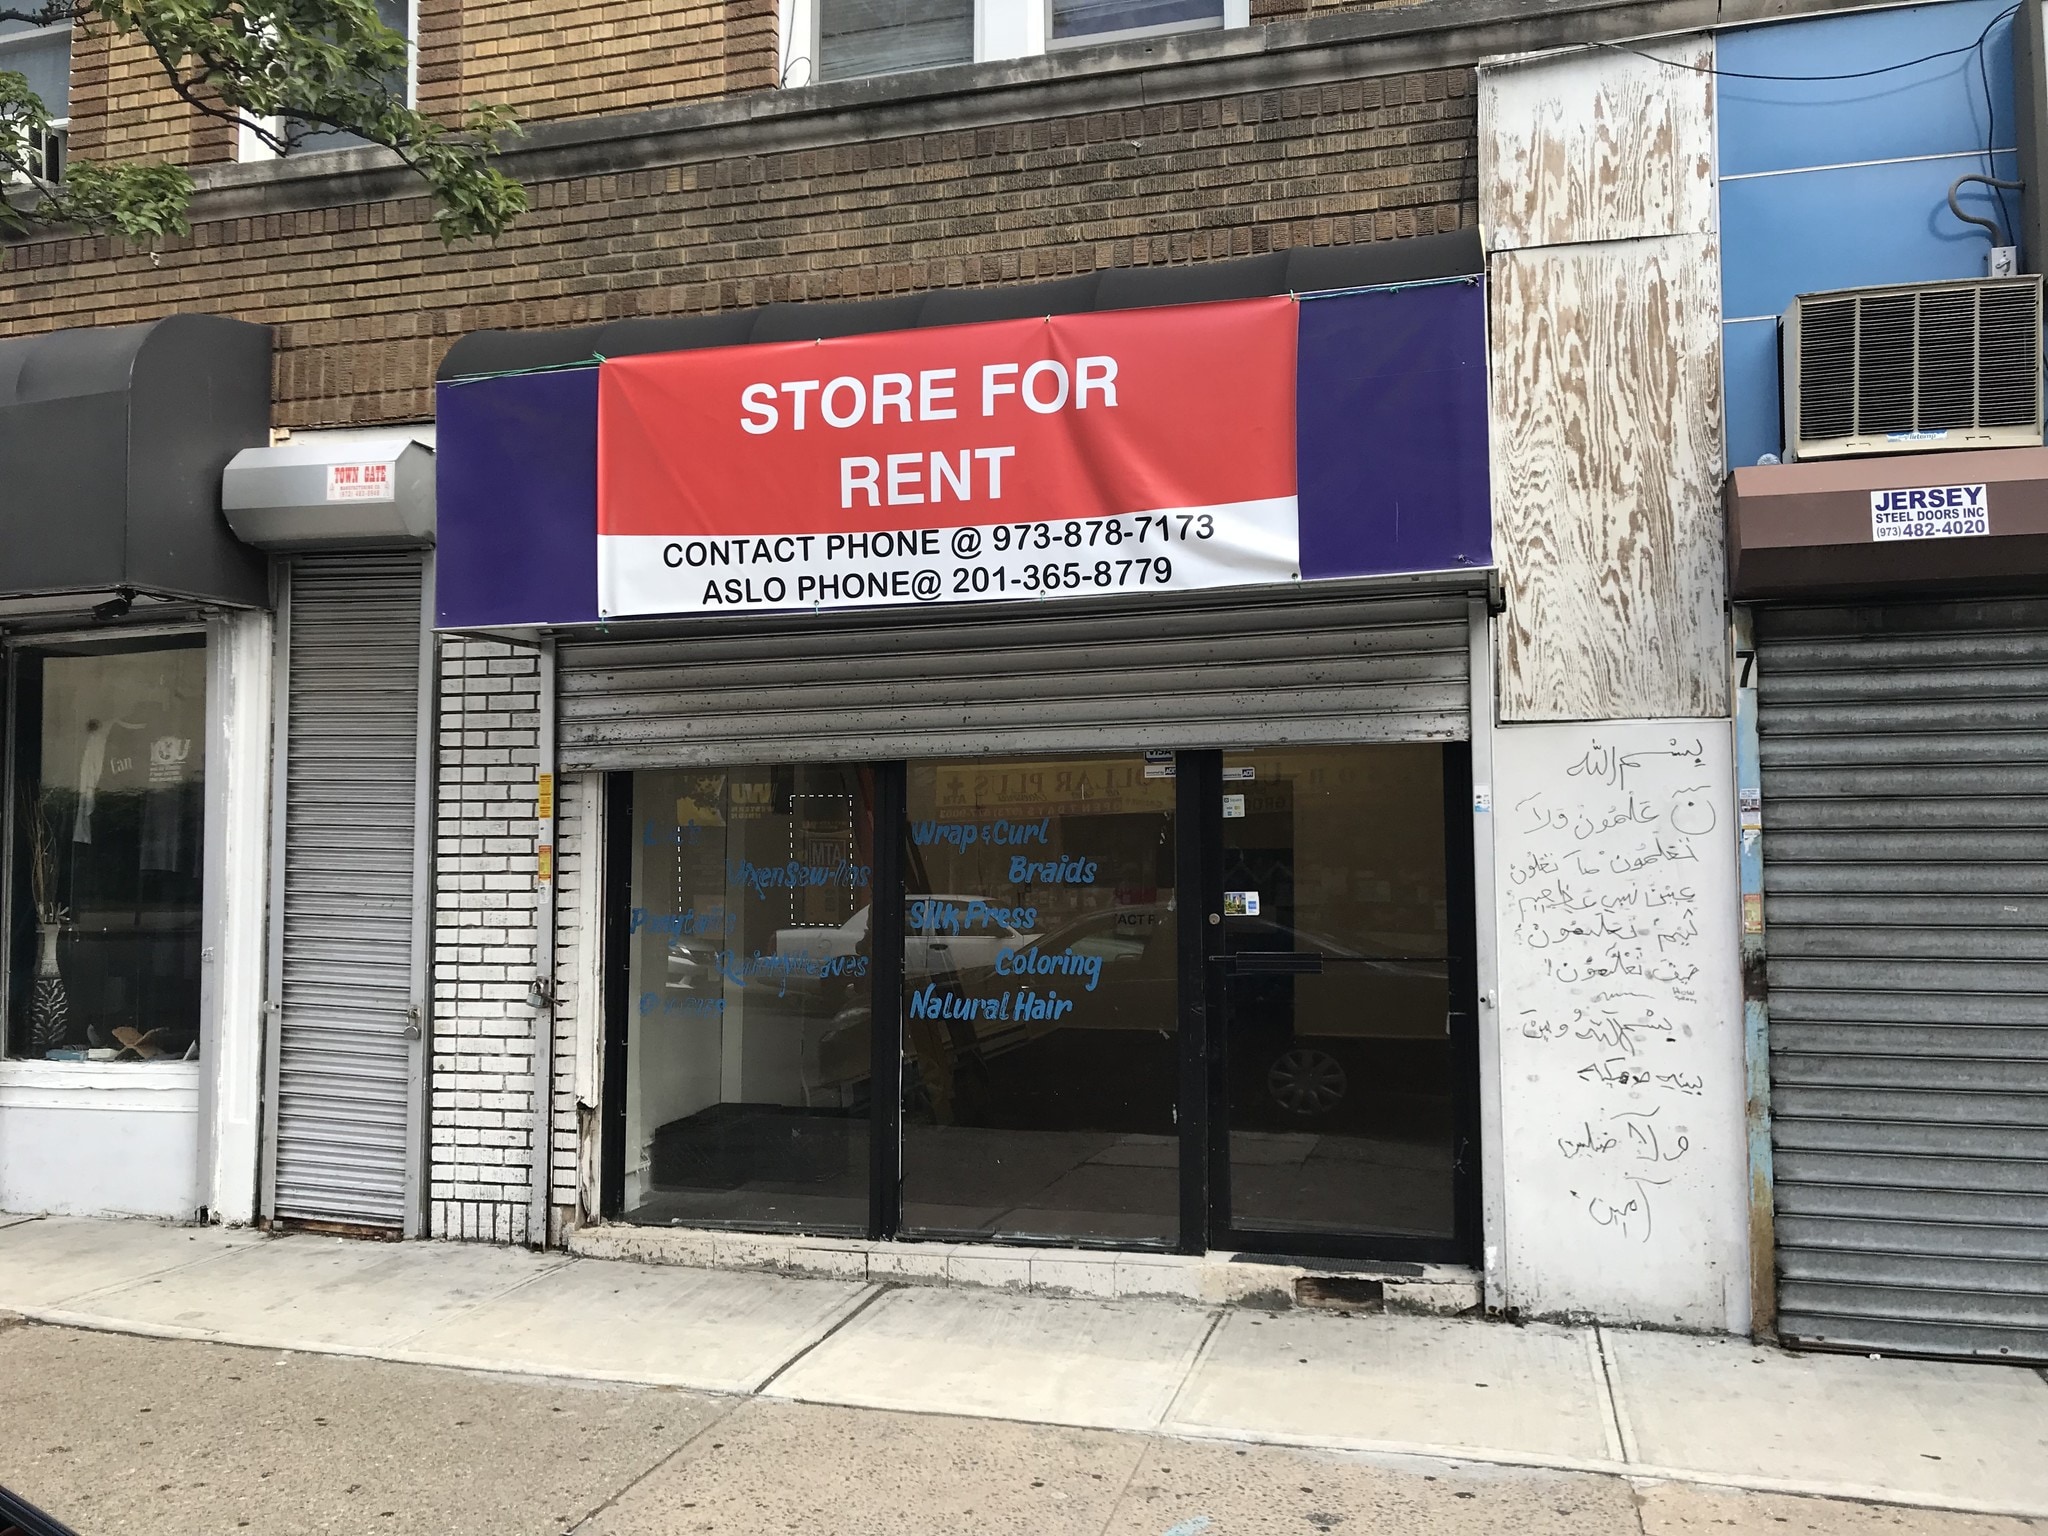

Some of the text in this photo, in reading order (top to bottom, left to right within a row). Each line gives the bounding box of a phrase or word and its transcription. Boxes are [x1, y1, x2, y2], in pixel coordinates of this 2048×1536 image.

[738, 354, 1120, 435] STORE FOR
[335, 465, 386, 483] TOWN GATE
[840, 446, 1016, 509] RENT
[1874, 486, 1983, 512] JERSEY
[1876, 507, 1985, 524] STEEL DOORS INC
[663, 514, 1216, 568] CONTACT PHONE @ 973-878-7173
[1876, 519, 1986, 539] (973) 482-4020
[702, 557, 1173, 605] ASLO PHONE@ 201-365-8779
[1735, 651, 1755, 688] 7
[911, 820, 977, 854] Wrap
[992, 818, 1050, 846] Curl
[1008, 854, 1098, 884] Braids
[910, 899, 1037, 936] Silk Press
[995, 947, 1103, 991] Coloring
[910, 982, 1073, 1020] Natural Hair
